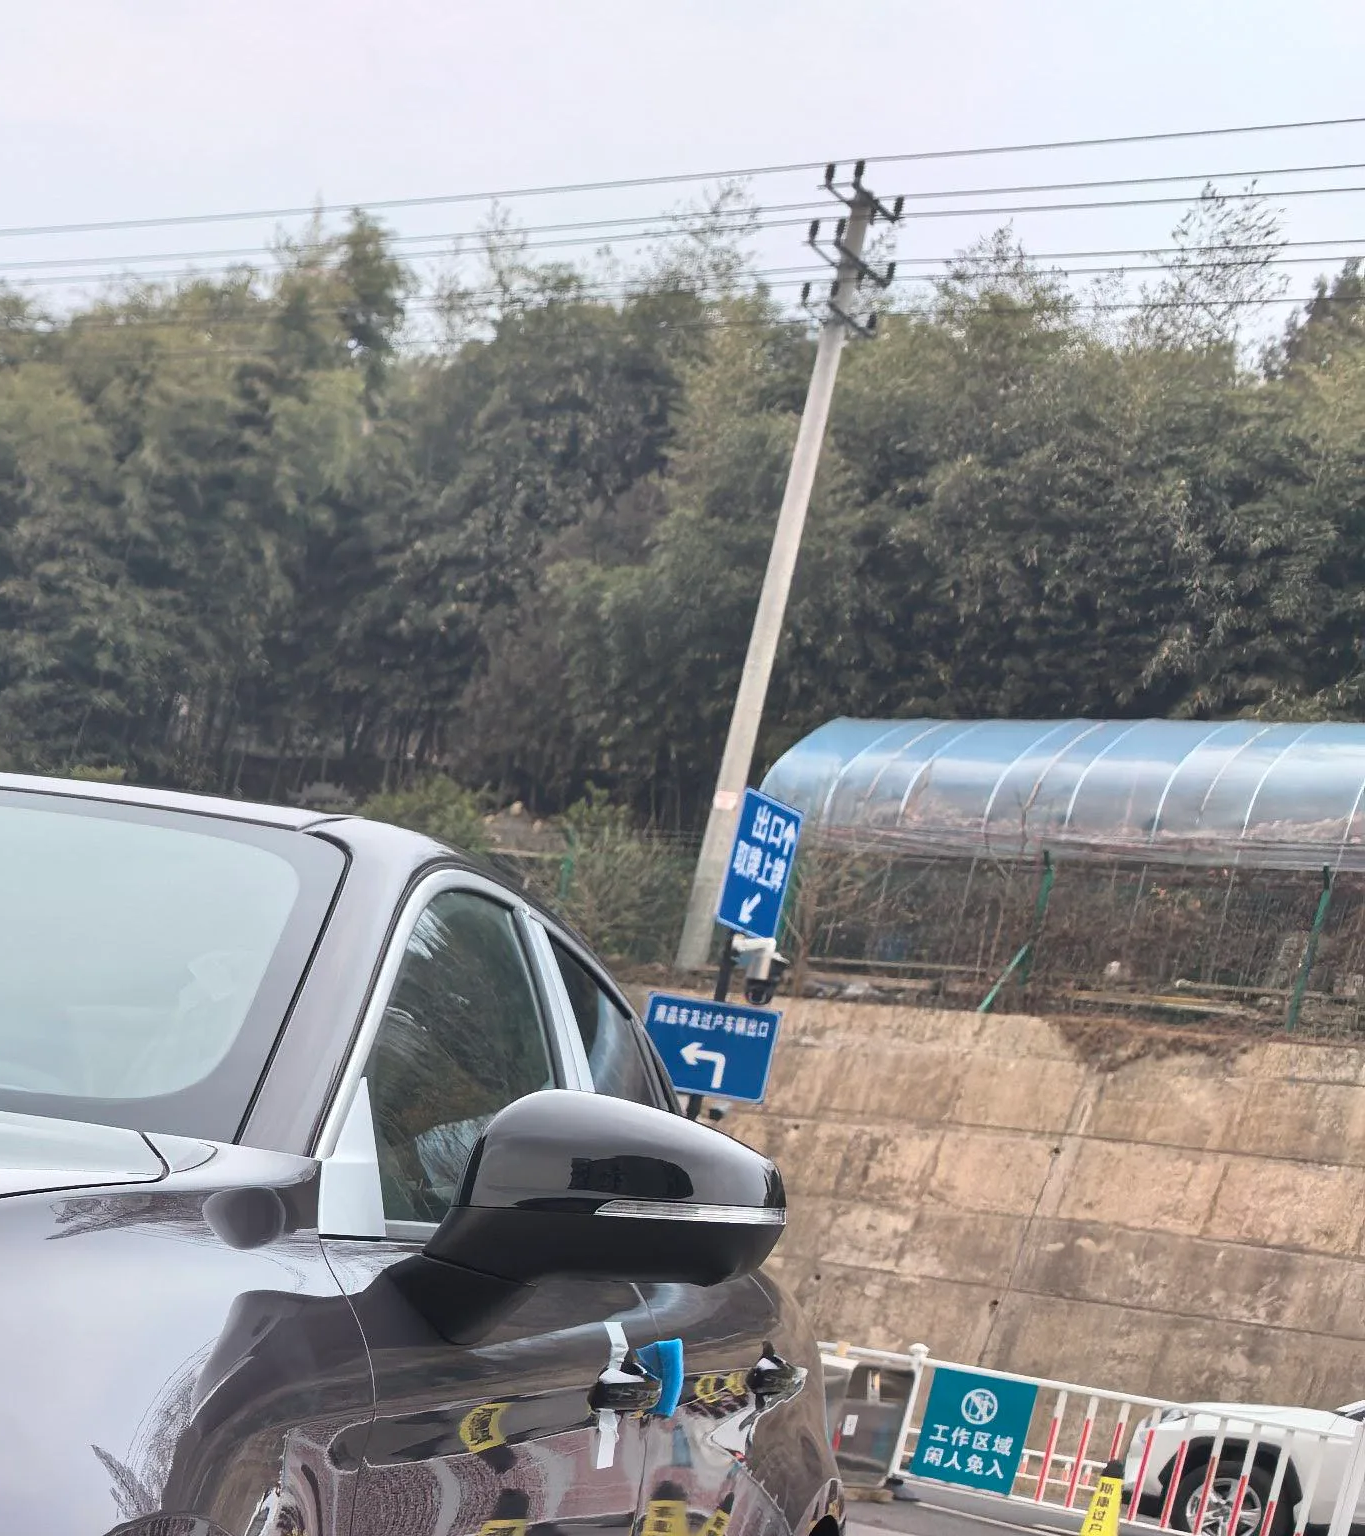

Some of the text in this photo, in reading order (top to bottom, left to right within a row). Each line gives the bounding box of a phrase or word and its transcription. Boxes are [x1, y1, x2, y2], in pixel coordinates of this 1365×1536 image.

[751, 805, 786, 848] 出口
[929, 1423, 1013, 1456] 工作区域
[923, 1446, 1004, 1479] 闲人免入
